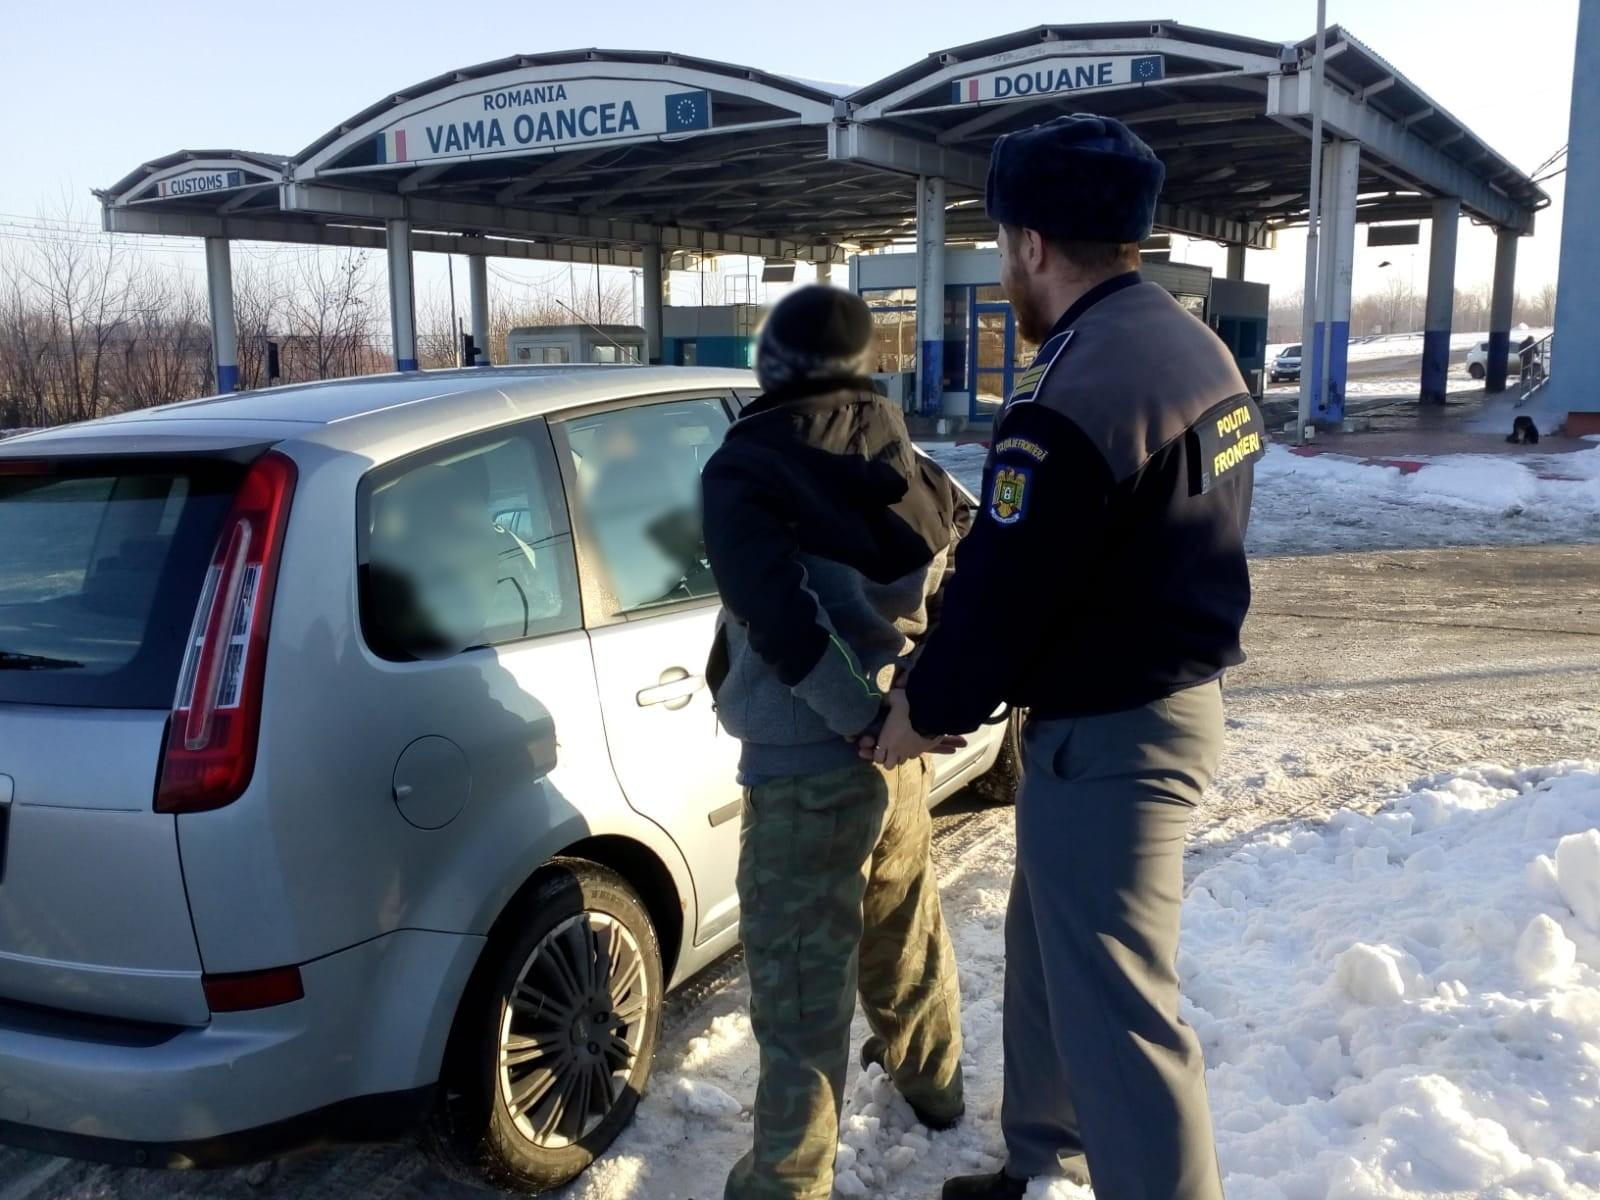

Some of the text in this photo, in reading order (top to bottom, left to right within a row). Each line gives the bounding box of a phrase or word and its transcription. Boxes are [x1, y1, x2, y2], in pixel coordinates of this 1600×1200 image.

[994, 62, 1113, 98] DOUANE
[483, 84, 567, 111] ROMANIA
[426, 100, 640, 154] VAMA OANCEA
[171, 174, 223, 194] CUSTOMS
